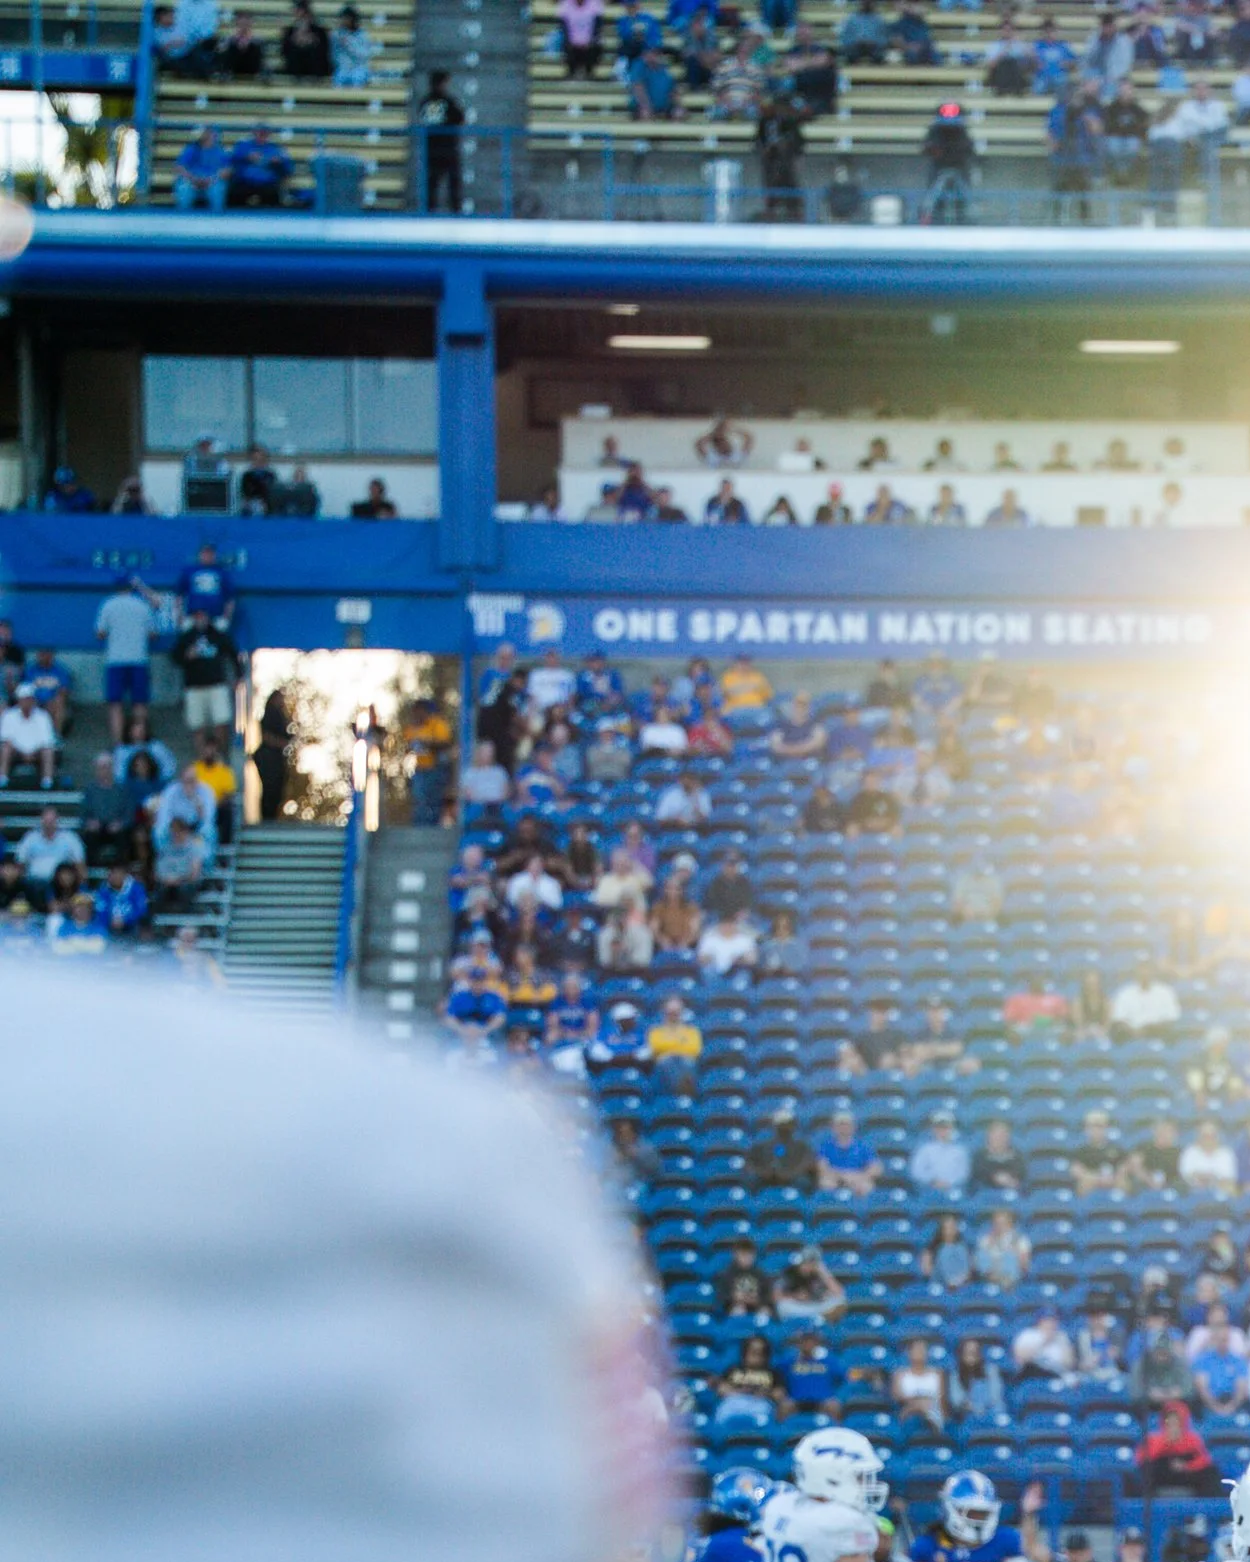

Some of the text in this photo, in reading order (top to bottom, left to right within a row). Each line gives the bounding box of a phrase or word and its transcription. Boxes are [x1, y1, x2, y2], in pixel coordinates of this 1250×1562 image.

[593, 607, 1213, 643] ONE SPARTAN NATION SEATING
